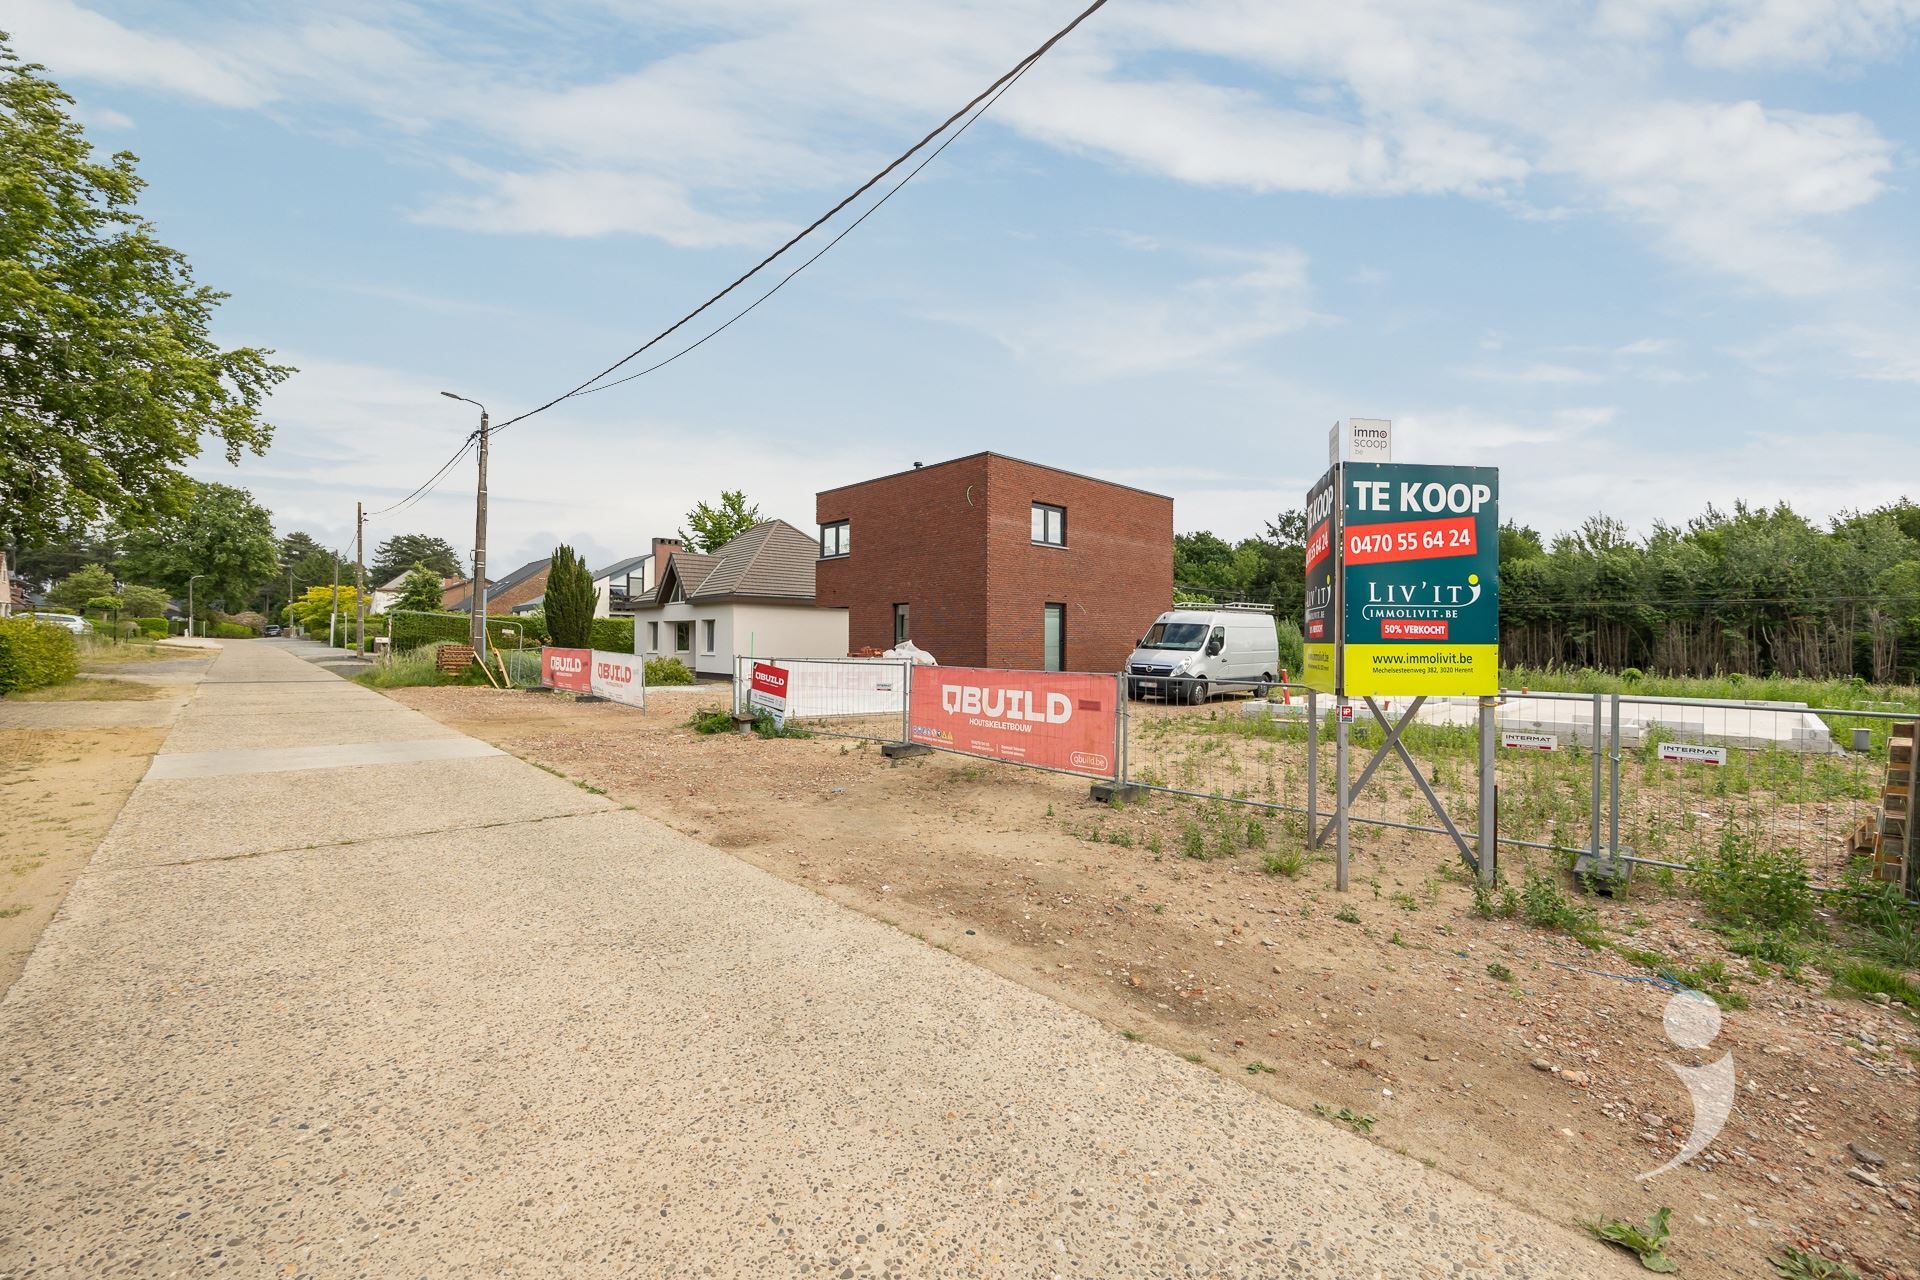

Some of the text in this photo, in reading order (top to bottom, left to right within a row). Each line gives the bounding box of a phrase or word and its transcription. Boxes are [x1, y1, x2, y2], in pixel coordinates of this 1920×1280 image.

[1354, 426, 1388, 439] immo
[1353, 439, 1388, 451] scoop
[1353, 480, 1491, 514] TE KOOP
[1312, 485, 1334, 526] KOOP
[1350, 528, 1471, 554] 0470 55 64 24
[1370, 609, 1458, 619] IMMOLIVIT.BE
[1384, 624, 1446, 635] 50% VERKOCHT
[1372, 652, 1473, 664] www.immolivit.be
[941, 684, 1073, 724] QBUILD
[969, 717, 1032, 734] HOUTSKELETBOUW
[1505, 734, 1552, 743] INTERMAT
[1663, 745, 1720, 756] INTERMAT
[1073, 754, 1105, 768] qbuild.be
